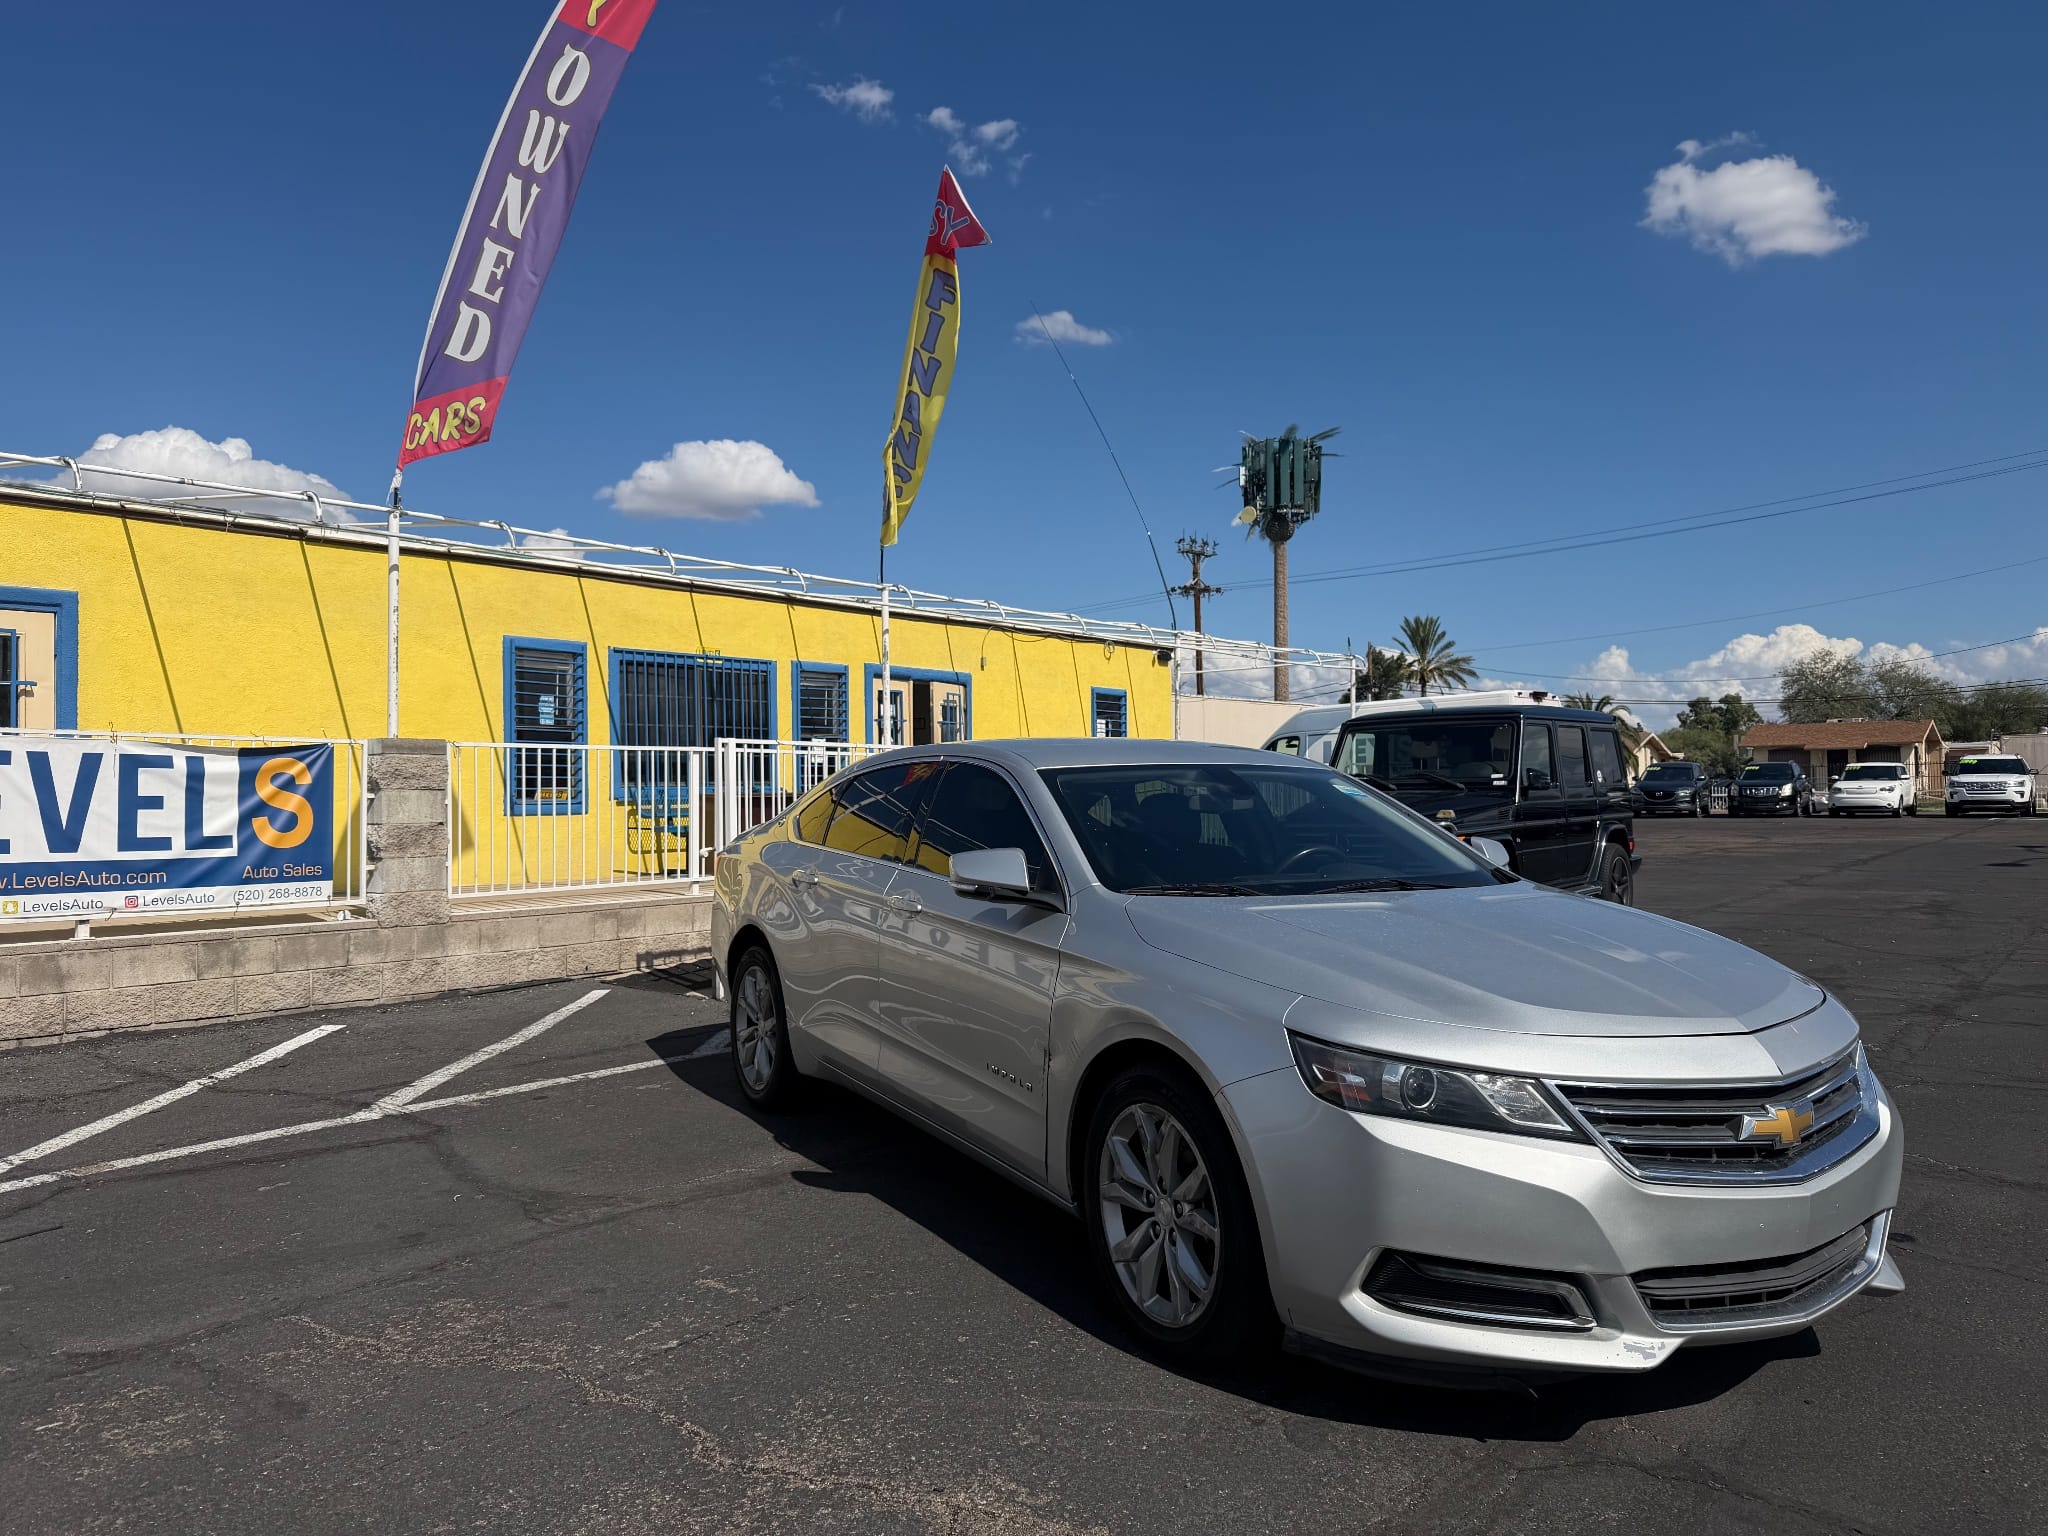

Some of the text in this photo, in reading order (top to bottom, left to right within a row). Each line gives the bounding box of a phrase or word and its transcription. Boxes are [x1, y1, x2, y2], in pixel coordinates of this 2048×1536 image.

[443, 43, 592, 364] OWNED
[404, 396, 487, 450] CARS
[0, 751, 313, 854] VELS
[242, 862, 323, 879] Auto Sales
[142, 892, 215, 907] LevelsAuto
[232, 886, 323, 903] (520) 268-8878
[23, 898, 104, 913] LevelsAuto
